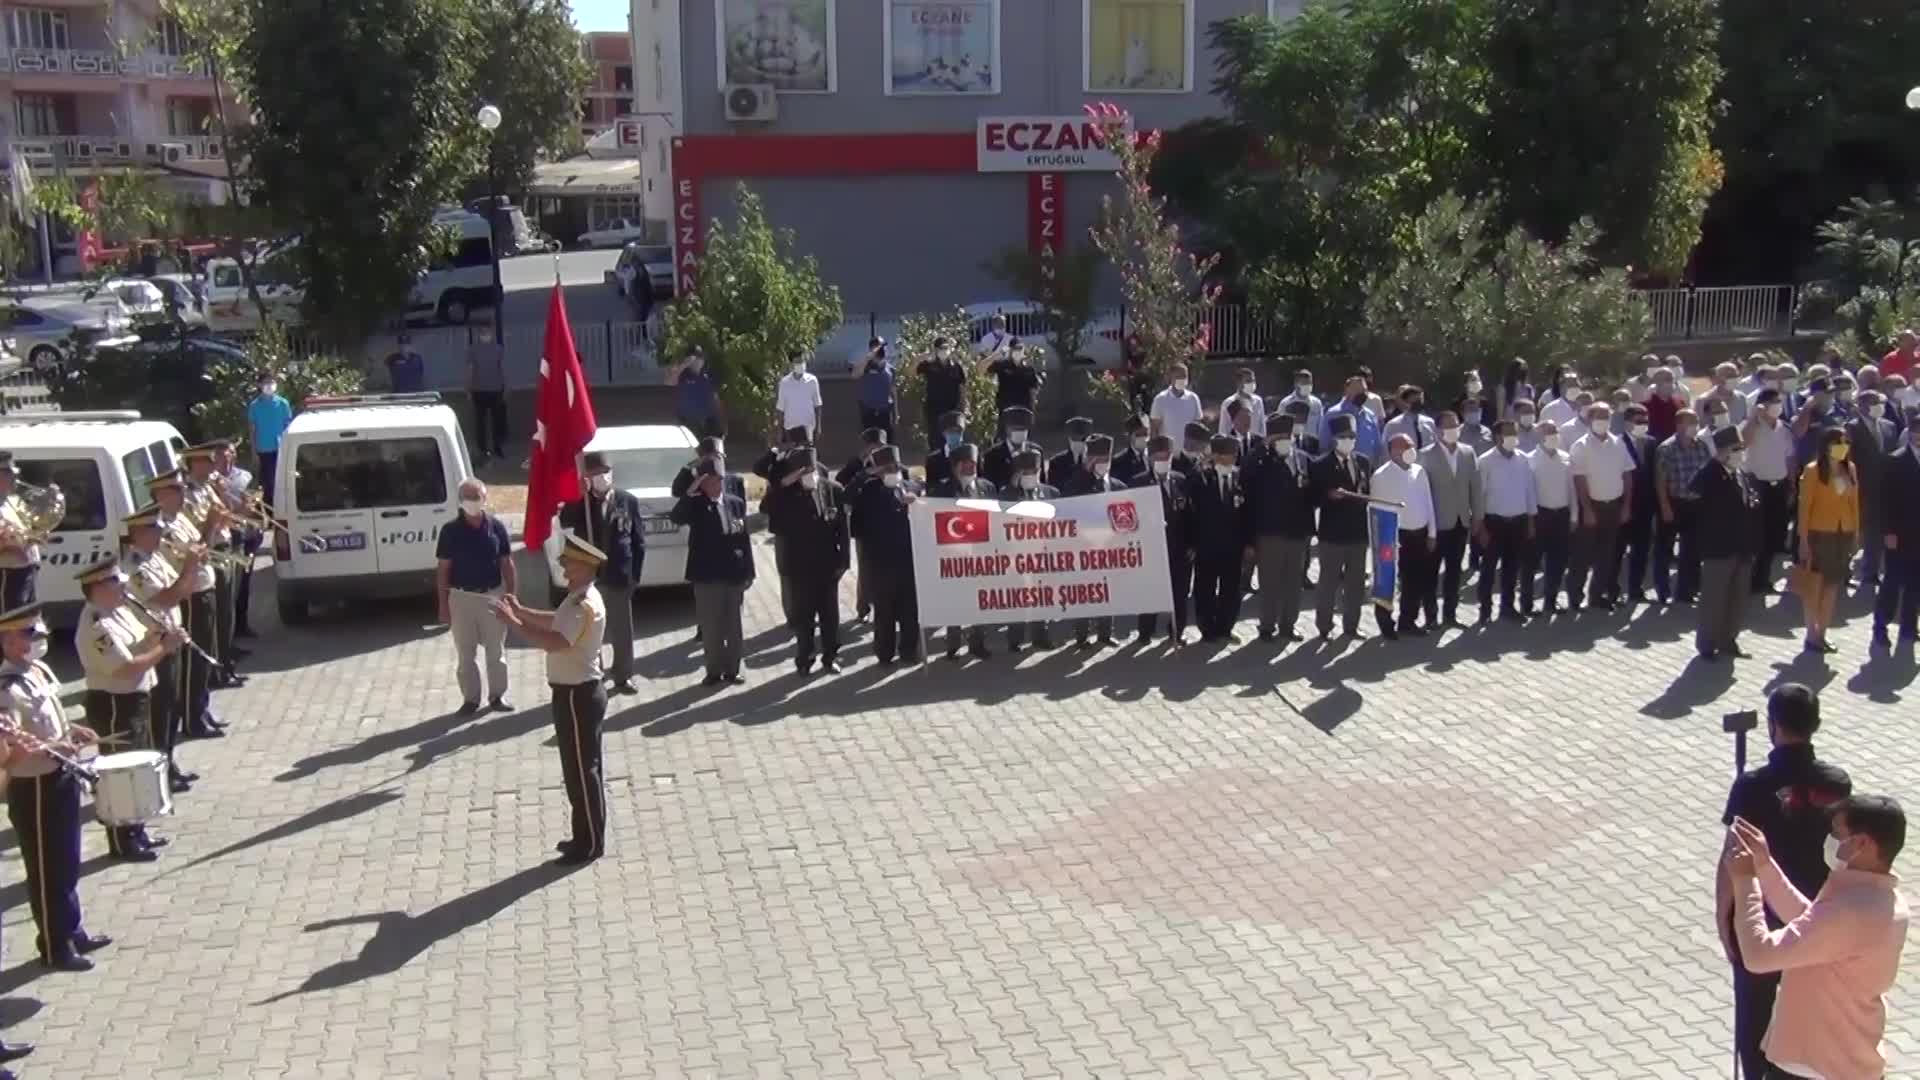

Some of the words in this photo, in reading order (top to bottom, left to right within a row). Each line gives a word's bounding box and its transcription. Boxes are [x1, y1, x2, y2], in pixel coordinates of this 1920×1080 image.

[985, 122, 1108, 151] ECZAN
[1026, 154, 1086, 166] ERTUĞRUL
[679, 179, 697, 290] ECZAN
[390, 525, 437, 544] POLİ
[939, 549, 1011, 579] MUHARİP
[1014, 546, 1077, 574] GAZİLER
[1079, 541, 1143, 570] DERNEĞİ
[977, 579, 1055, 611] BALIKESİR
[1058, 576, 1110, 612] ŞUBESİ
